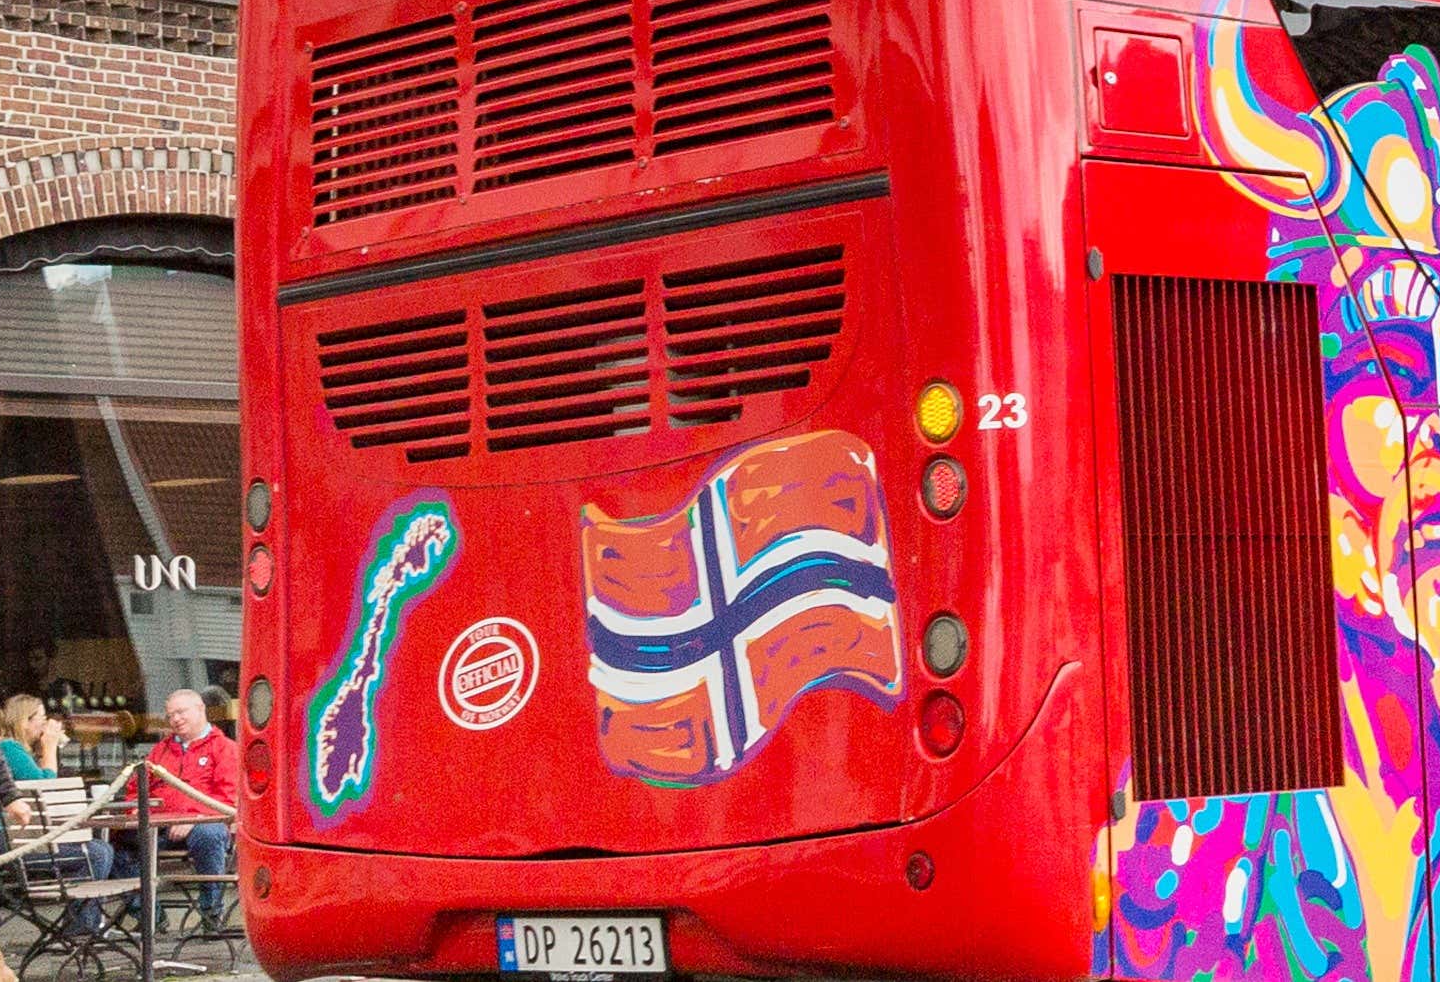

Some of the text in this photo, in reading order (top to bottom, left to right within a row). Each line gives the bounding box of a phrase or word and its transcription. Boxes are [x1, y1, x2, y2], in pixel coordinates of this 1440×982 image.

[976, 393, 1027, 431] 23
[457, 655, 519, 693] OFFICIAL
[523, 925, 655, 966] DP 26213
